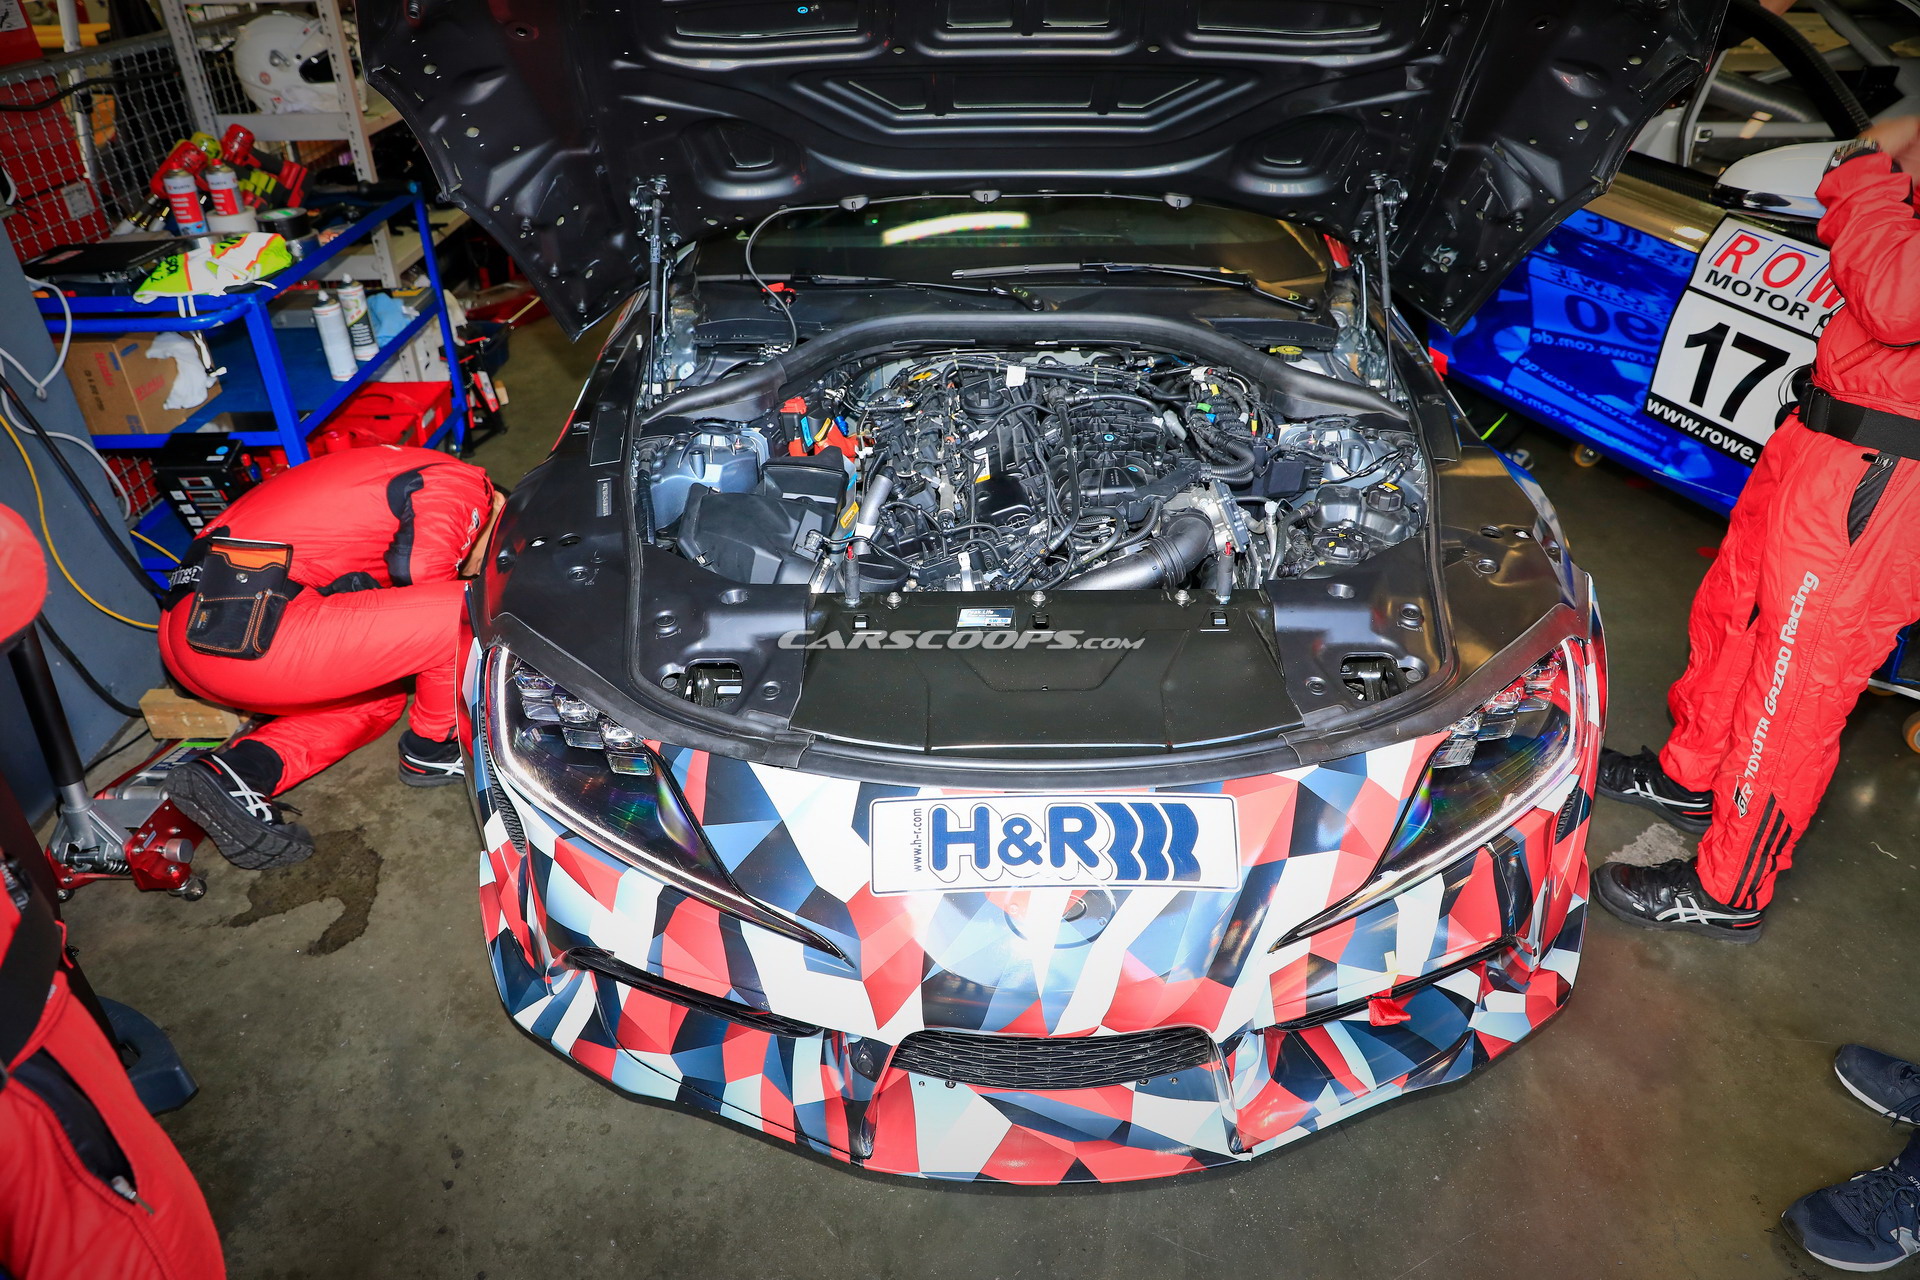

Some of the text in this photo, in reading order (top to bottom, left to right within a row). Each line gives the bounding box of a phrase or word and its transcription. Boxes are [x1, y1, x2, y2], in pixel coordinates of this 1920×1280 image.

[1704, 269, 1810, 321] MOTOR
[1646, 398, 1757, 464] www.rowe.
[1744, 716, 1771, 780] TOYOTA
[1764, 645, 1792, 717] GAZOO
[1780, 570, 1820, 645] Racing
[909, 807, 922, 873] www.h-r.com
[931, 805, 1100, 872] H&R
